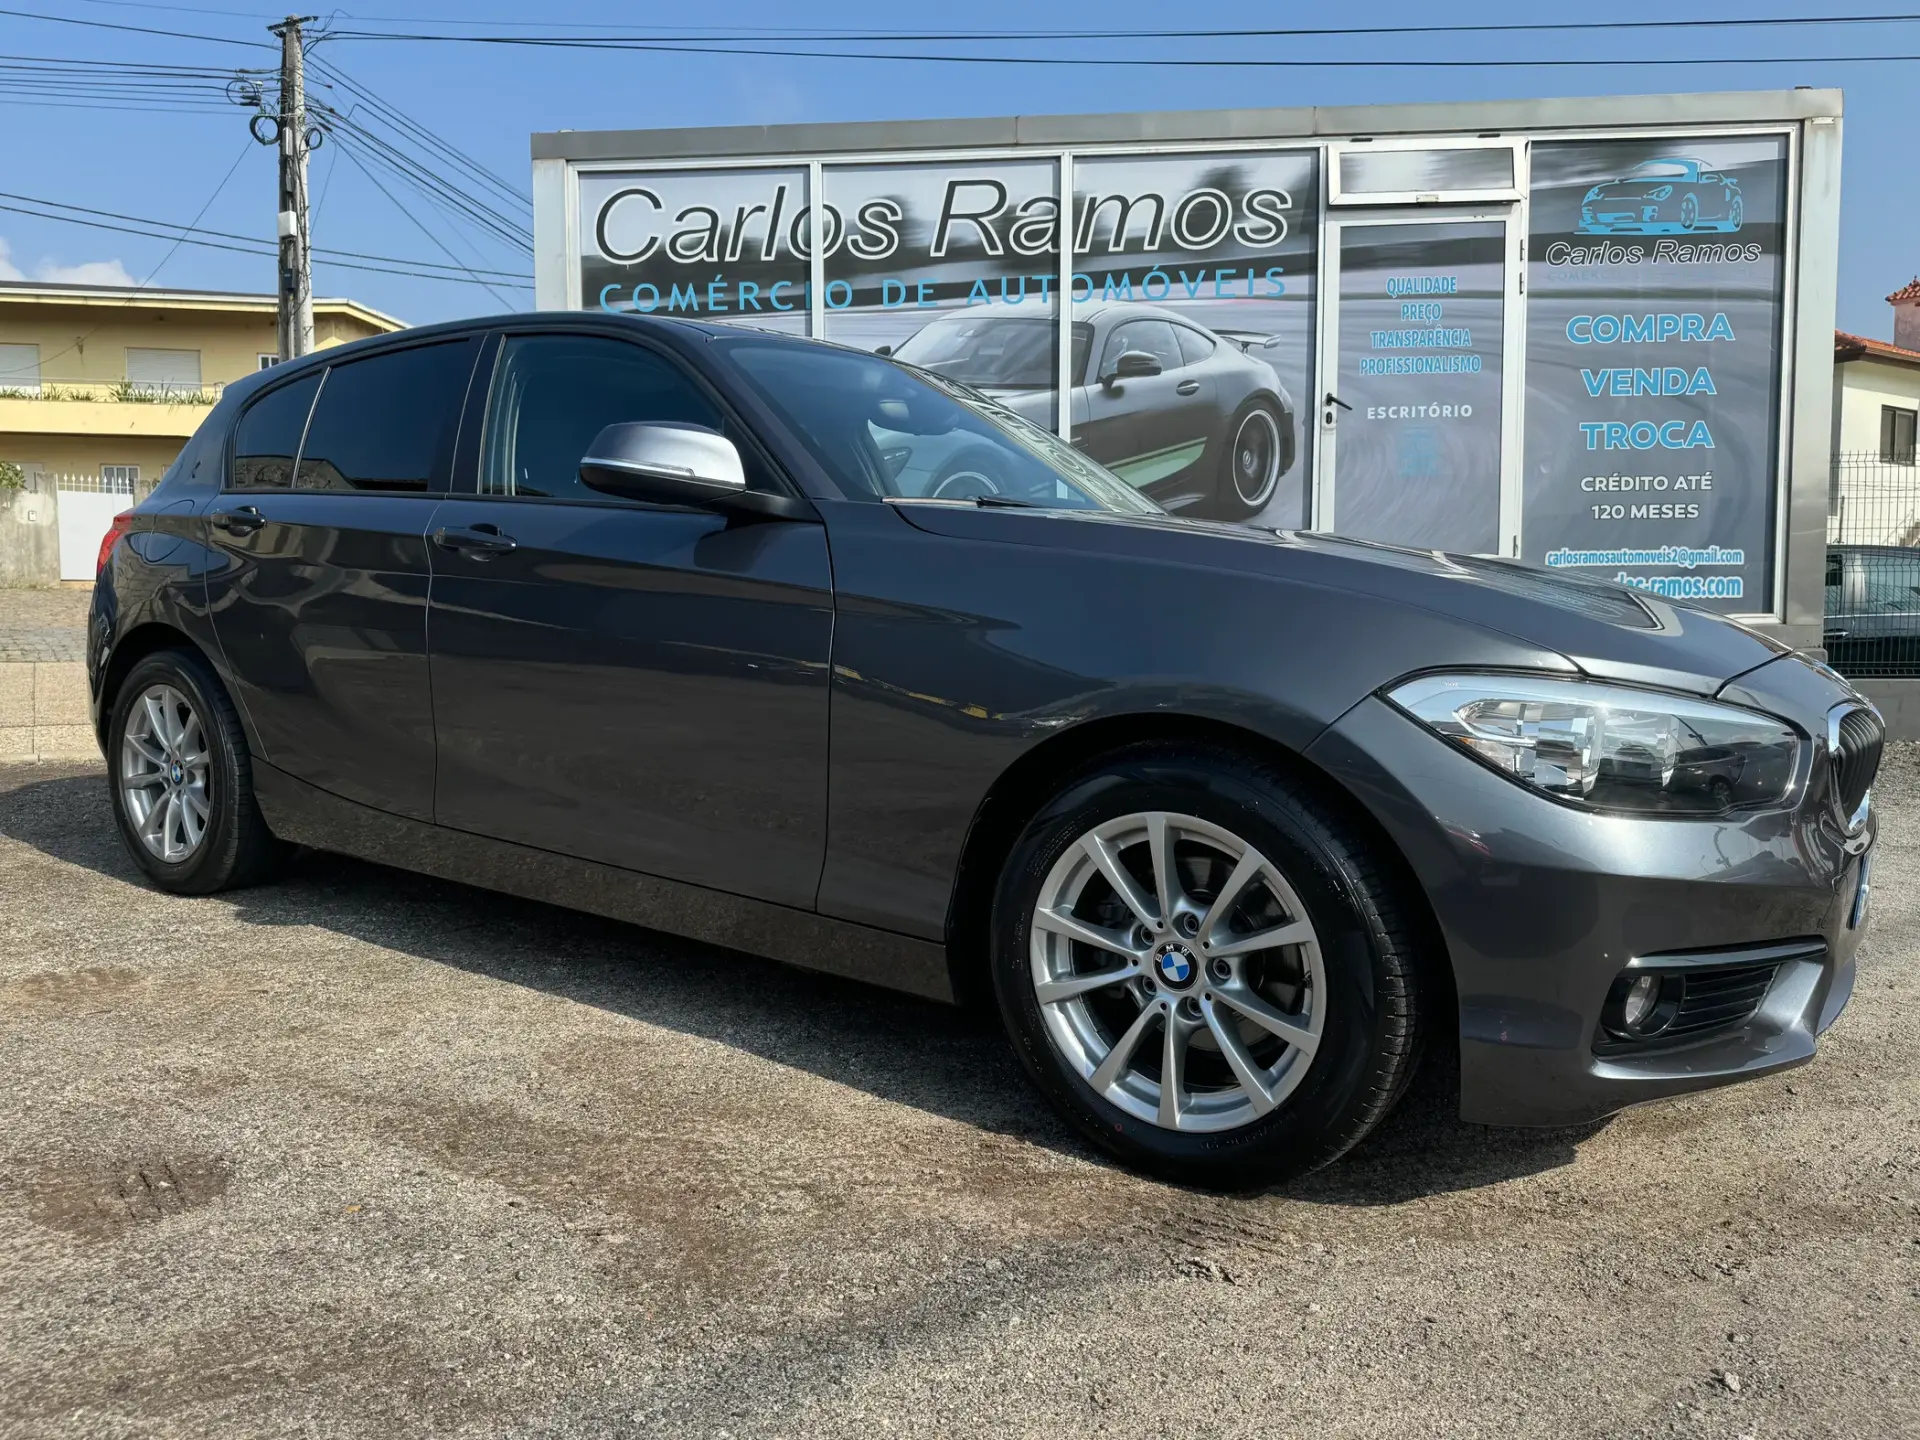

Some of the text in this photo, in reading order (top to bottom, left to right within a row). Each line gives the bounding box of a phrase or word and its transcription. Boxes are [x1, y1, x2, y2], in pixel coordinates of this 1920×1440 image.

[594, 178, 1293, 265] Carlos Ramos
[1545, 239, 1762, 267] Carlos Ramos
[600, 264, 1286, 313] COMÉRCIO DE AUTOMÓVEIS
[1386, 276, 1457, 298] QUALIDADE
[1401, 303, 1442, 325] PREÇO
[1370, 324, 1472, 349] TRANSPARÊNCIA
[1566, 313, 1736, 344] COMPRA
[1360, 355, 1481, 375] PROFISSIONALISMO
[1580, 367, 1717, 397] VENDA
[1367, 402, 1473, 420] ESCRITÓRIO
[1579, 420, 1716, 450] TROCA
[1580, 472, 1713, 492] CRÉDITO ATÉ
[1591, 504, 1700, 520] 120 MESES
[1545, 546, 1744, 568] carlosramosautomoveis2@gmail.com
[1155, 943, 1190, 962] BMW
